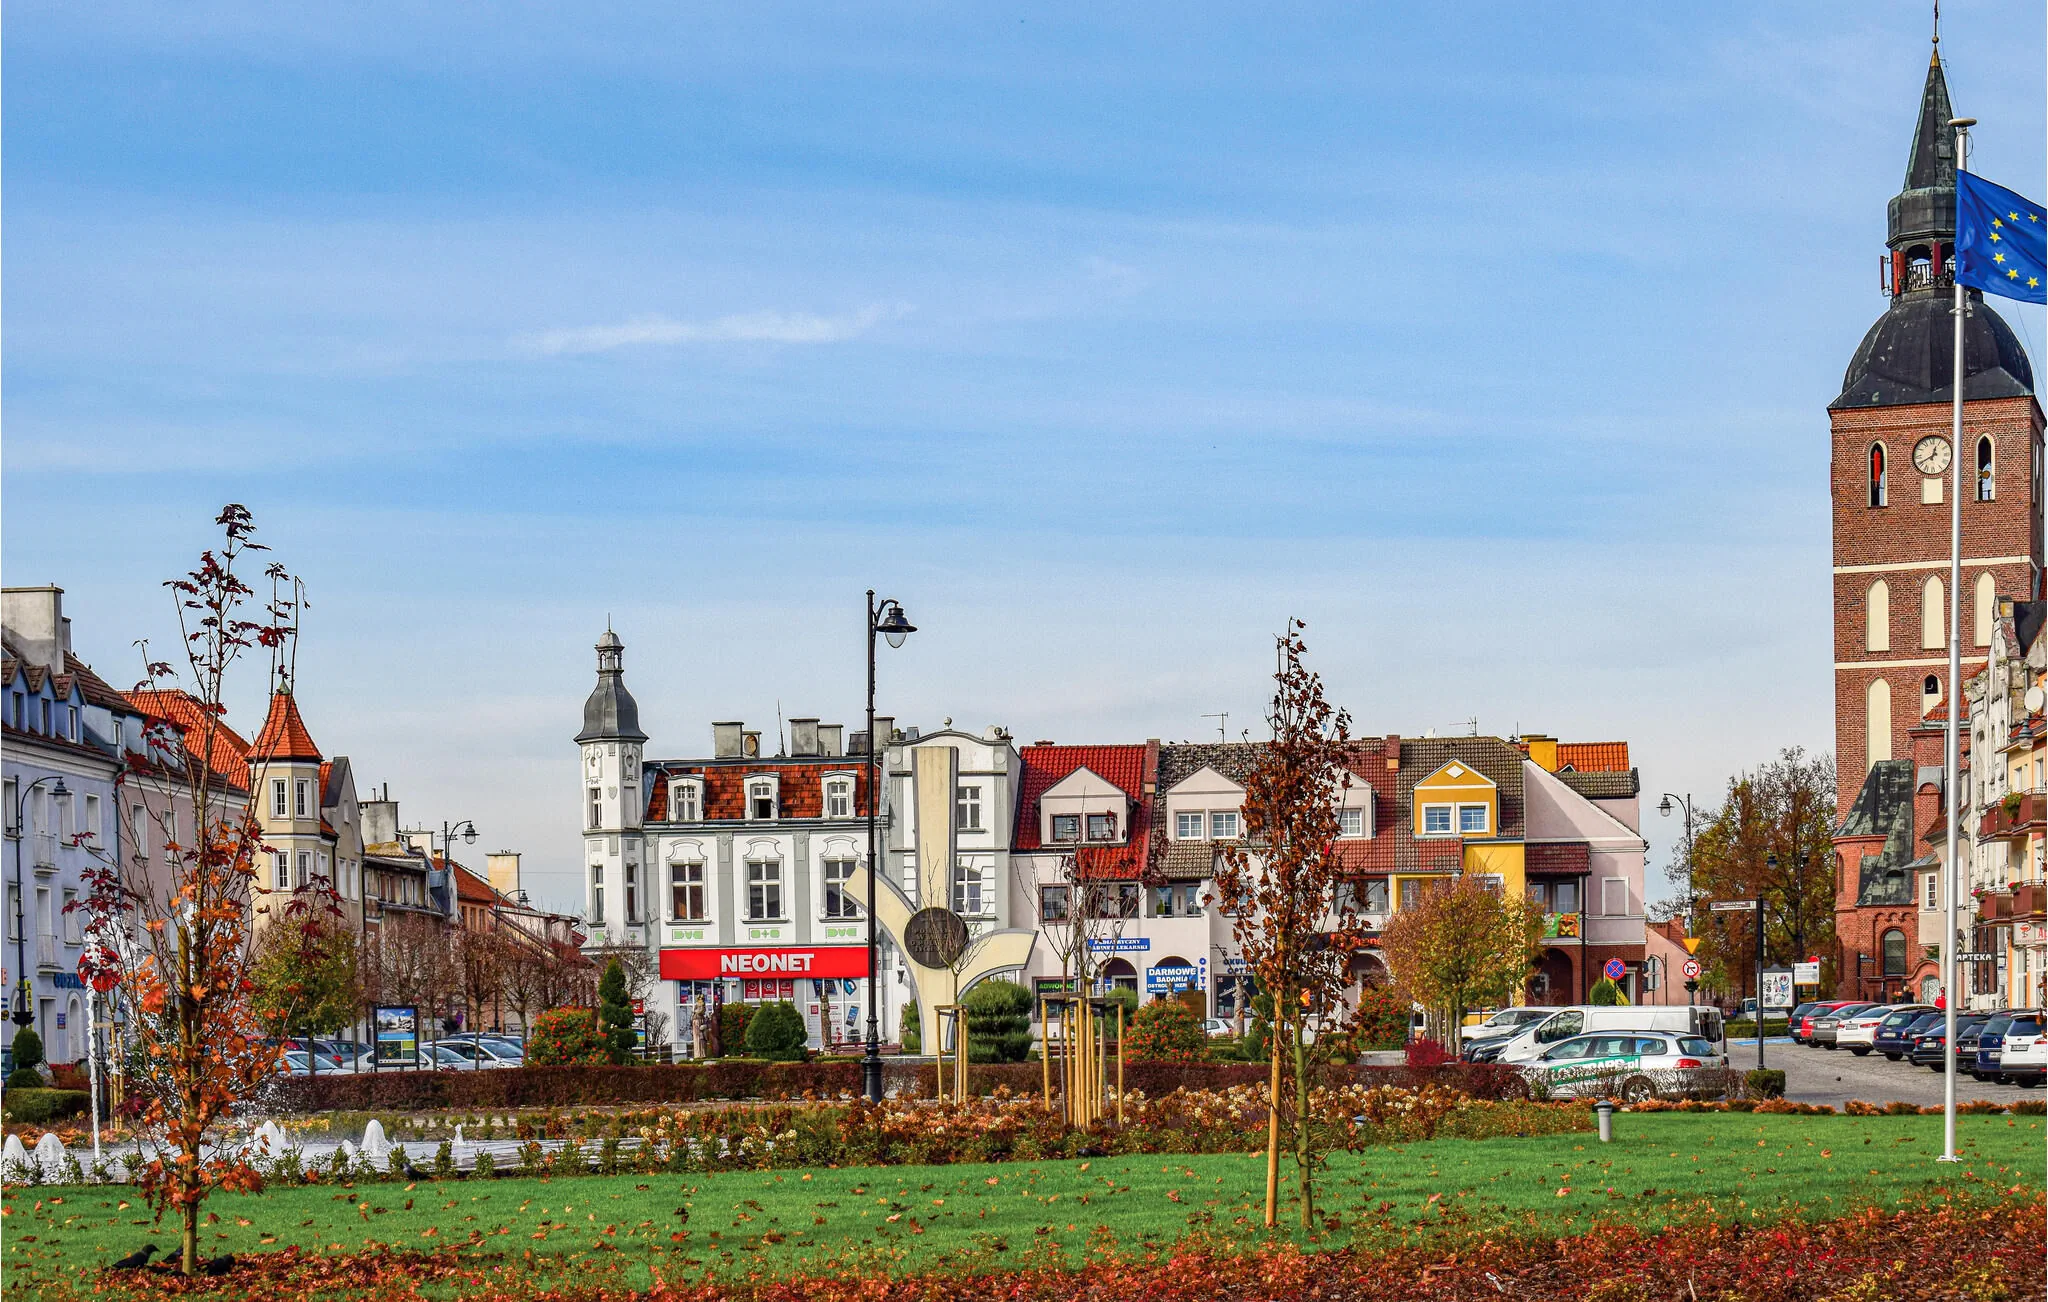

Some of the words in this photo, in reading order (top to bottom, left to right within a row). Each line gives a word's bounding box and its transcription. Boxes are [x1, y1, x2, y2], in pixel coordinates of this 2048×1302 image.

[1956, 953, 1992, 961] APTEKA
[721, 953, 814, 973] NEONET
[1148, 968, 1196, 976] DARMOWE
